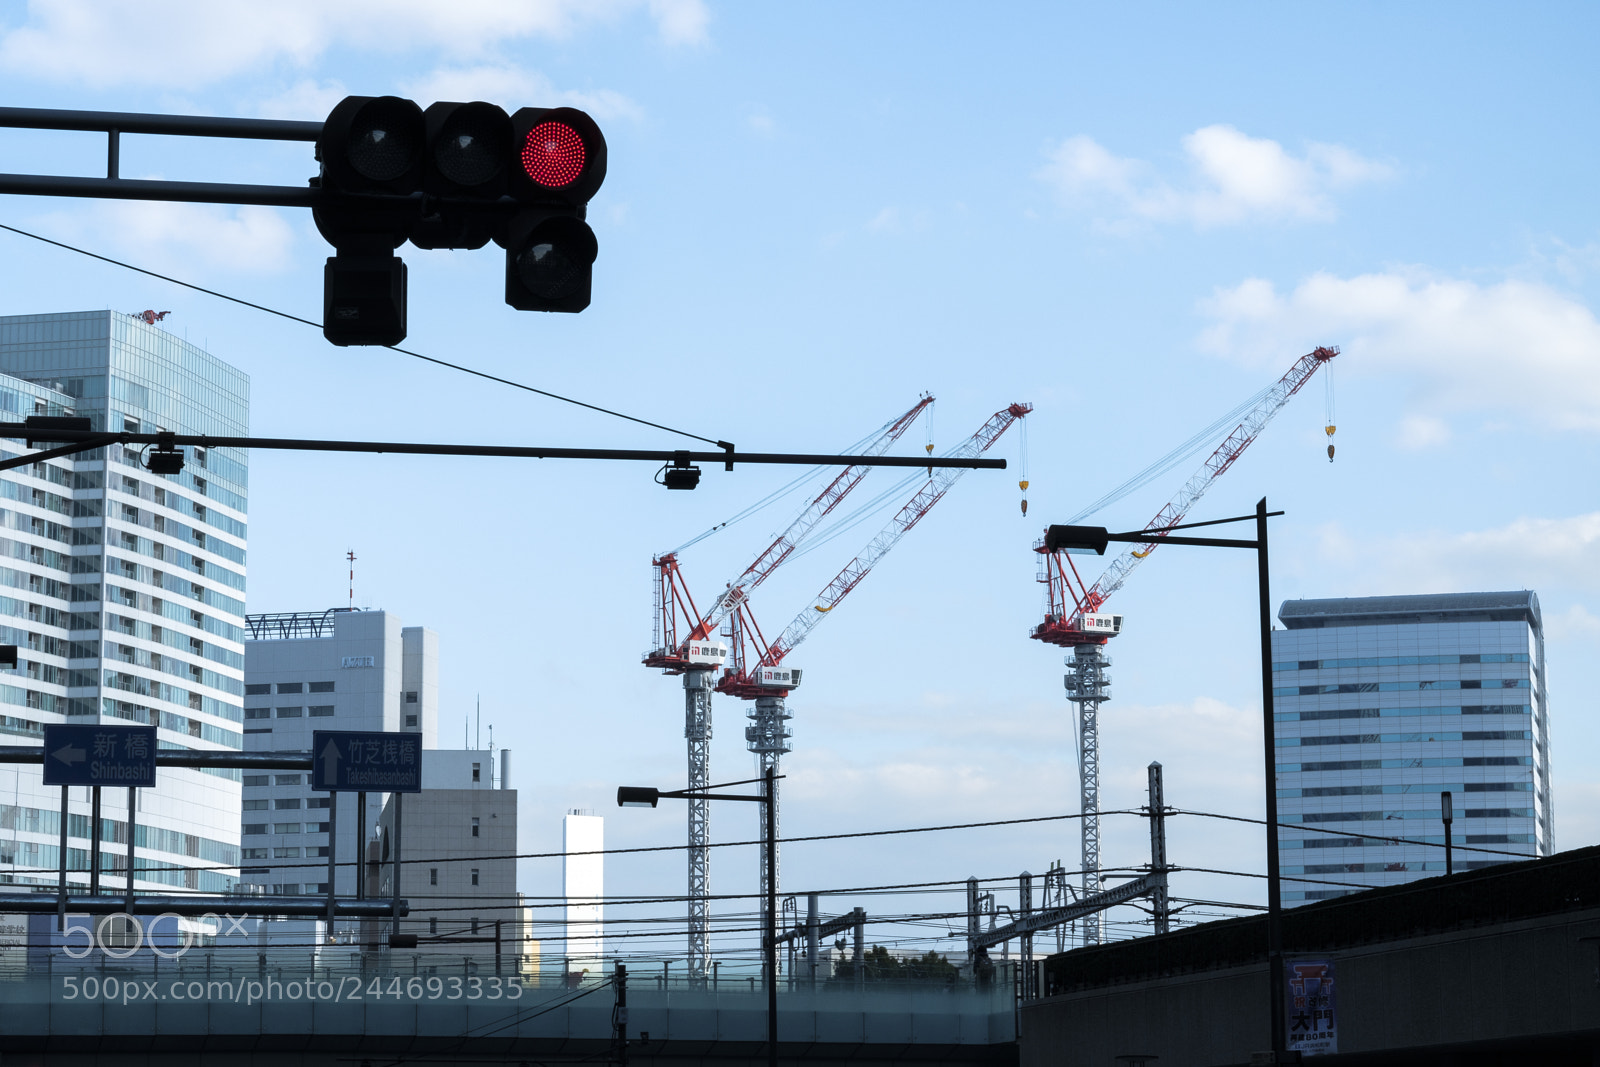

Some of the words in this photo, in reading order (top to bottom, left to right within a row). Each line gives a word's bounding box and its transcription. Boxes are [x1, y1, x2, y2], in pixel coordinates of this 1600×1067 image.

[701, 646, 719, 656] 鹿島
[93, 732, 148, 759] 新橋
[348, 739, 415, 765] 竹芝桟橋
[90, 761, 150, 780] Shinbashi
[347, 767, 416, 785] Takeshibasanbashi
[1291, 1009, 1333, 1031] 大門
